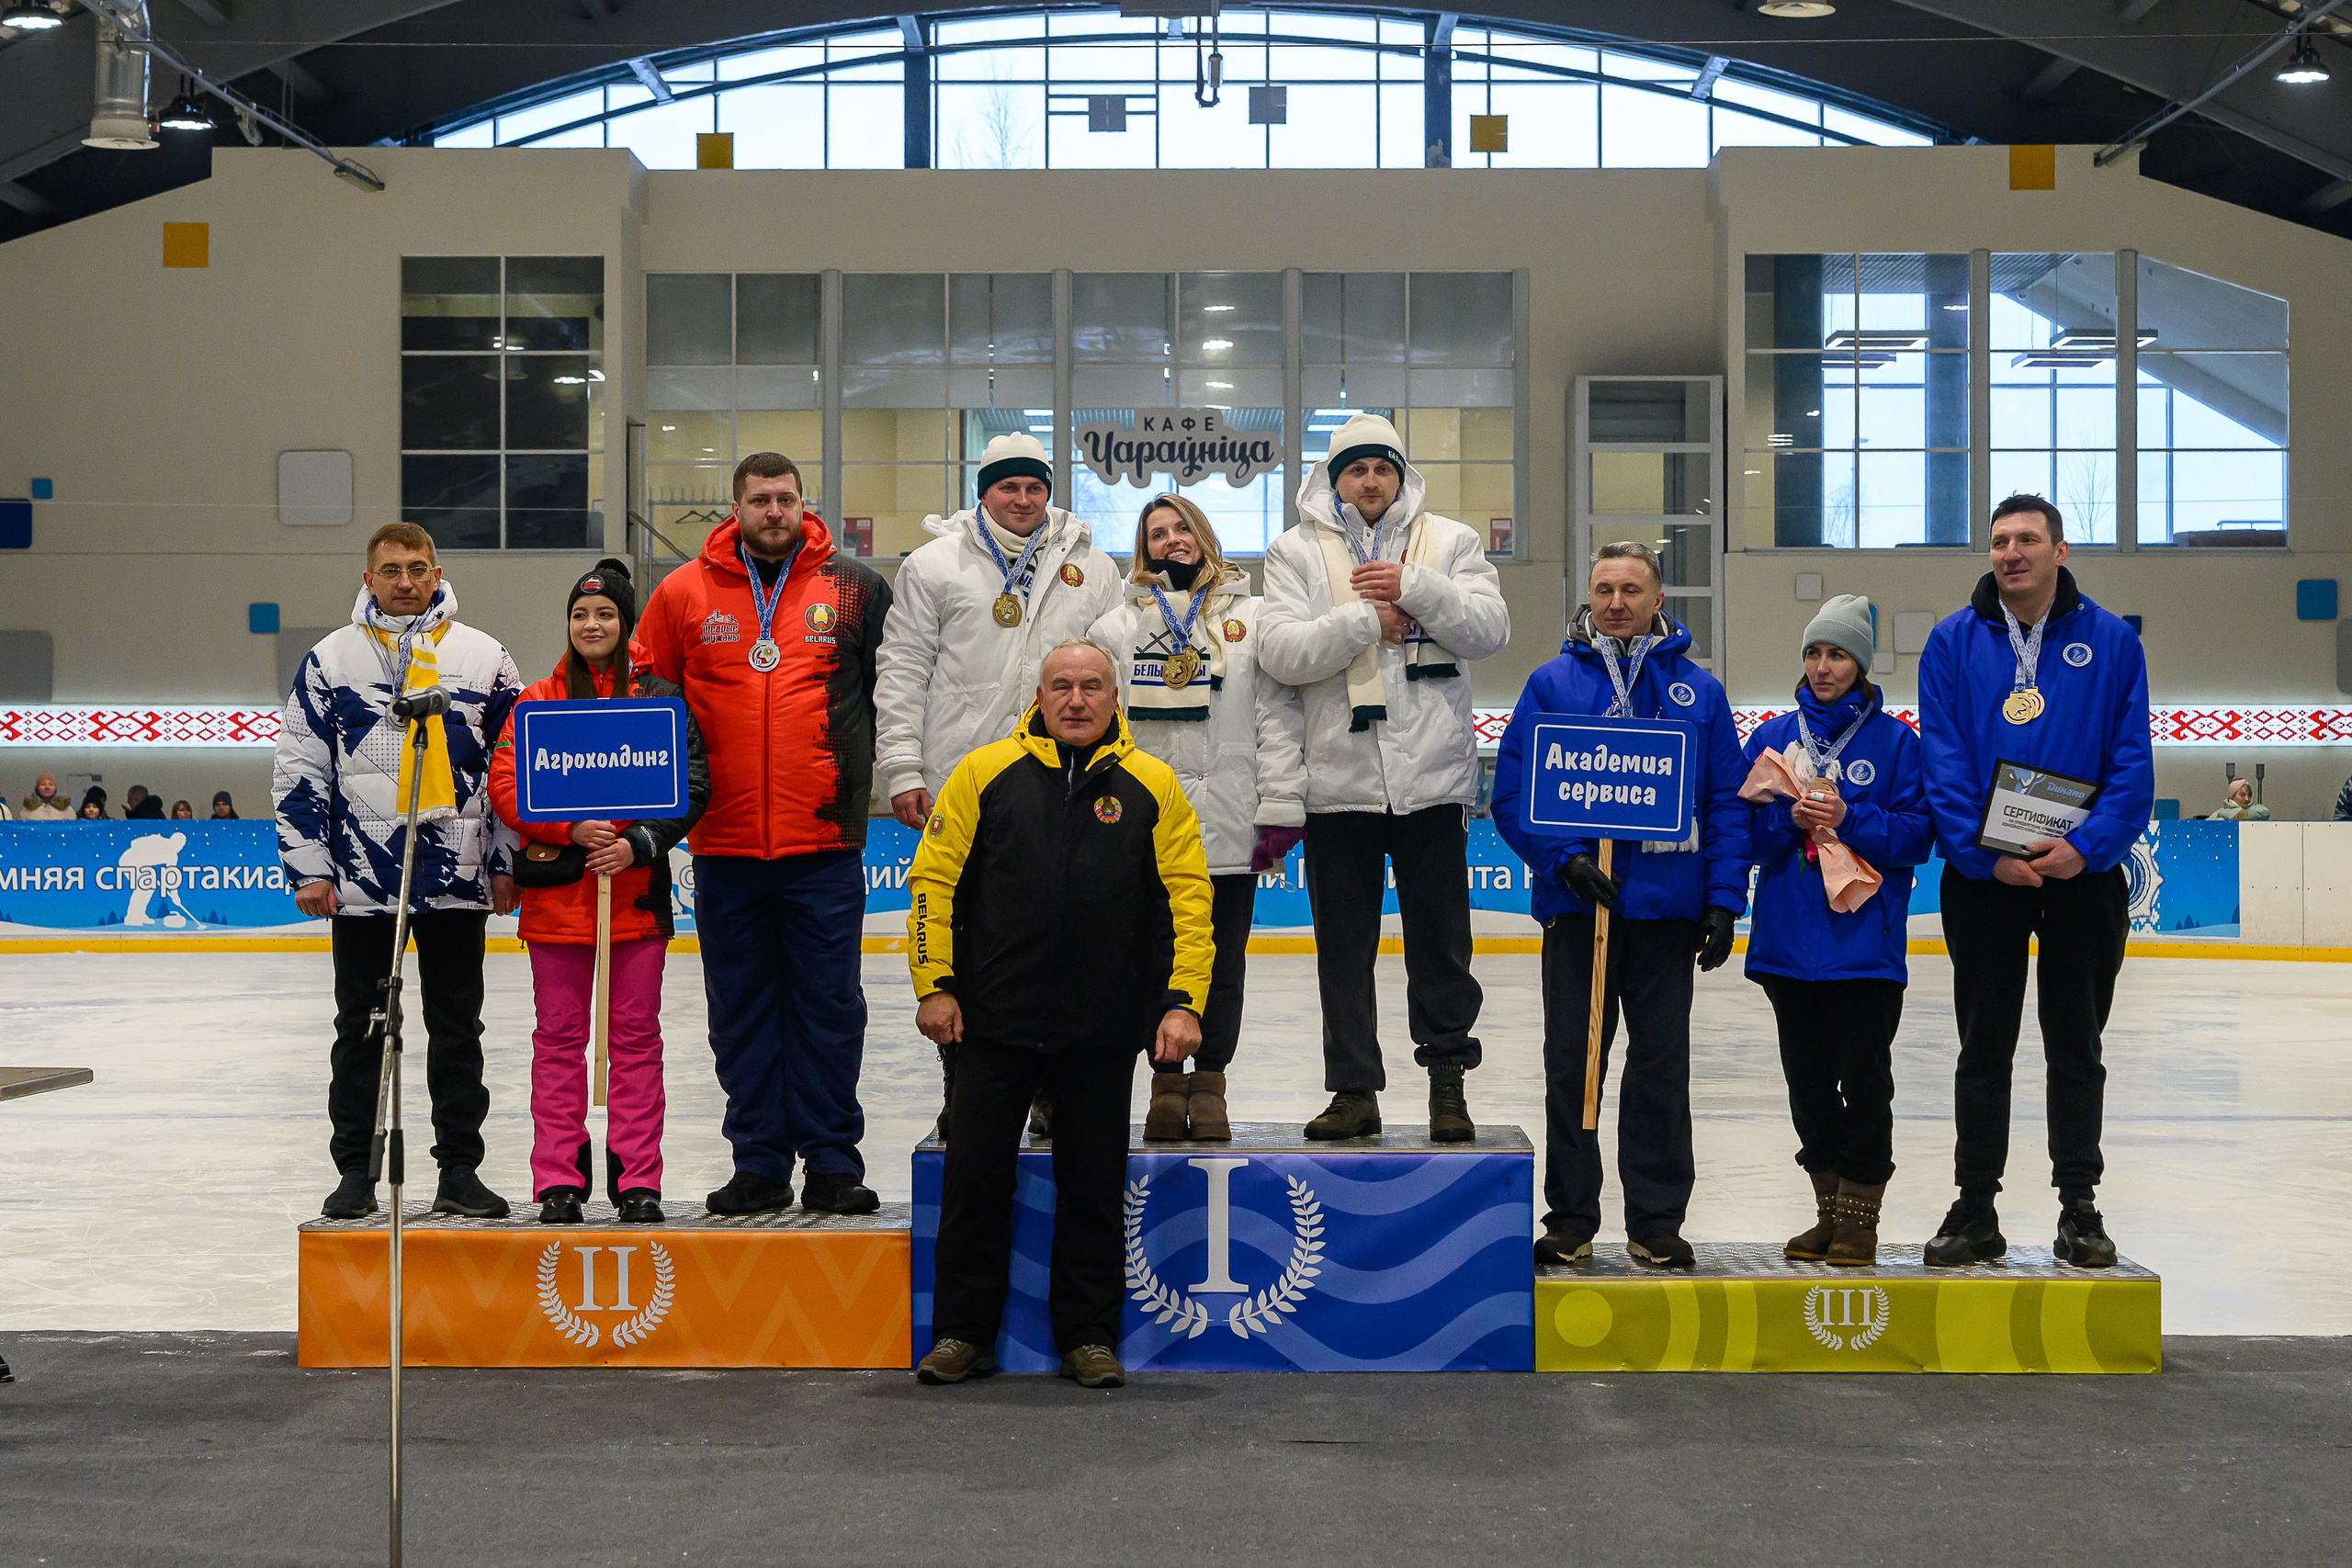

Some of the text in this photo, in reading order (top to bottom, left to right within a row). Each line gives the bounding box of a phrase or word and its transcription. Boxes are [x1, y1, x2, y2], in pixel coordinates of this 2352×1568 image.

[1144, 416, 1214, 432] КАФЕ
[1083, 431, 1275, 479] Чараўніца
[1134, 664, 1163, 678] БЕЛЫ
[534, 743, 670, 776] Агрохолдинг
[1544, 742, 1673, 776] Академия
[1558, 781, 1657, 810] сервиса
[2003, 805, 2075, 831] СЕРТИФИКАТ
[916, 892, 930, 964] BELARUS
[573, 1247, 639, 1311] II
[1818, 1289, 1876, 1325] III
